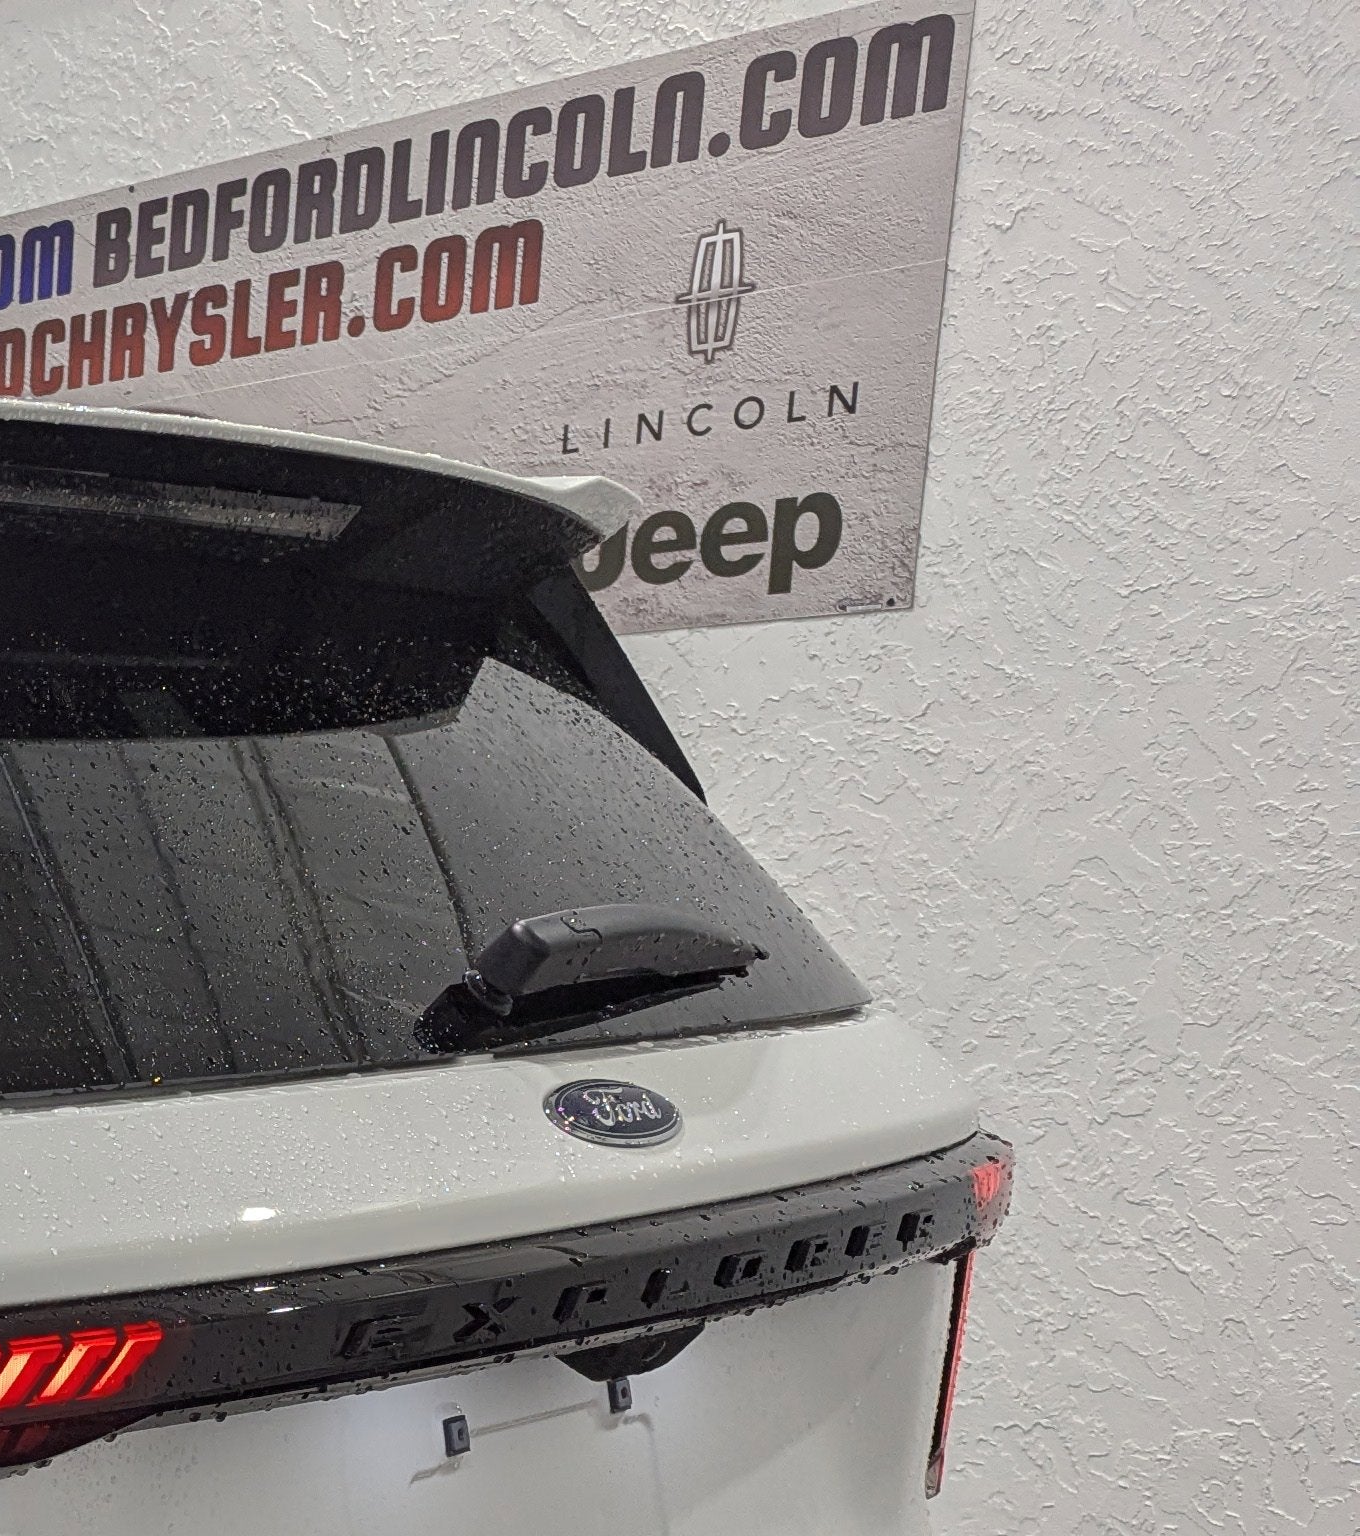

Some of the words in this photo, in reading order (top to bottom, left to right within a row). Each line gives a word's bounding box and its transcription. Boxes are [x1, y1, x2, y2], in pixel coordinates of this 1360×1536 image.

[92, 13, 956, 289] BEDFORDLINCOLN.COM
[560, 381, 860, 455] LINCOLN
[583, 1086, 662, 1126] Ford
